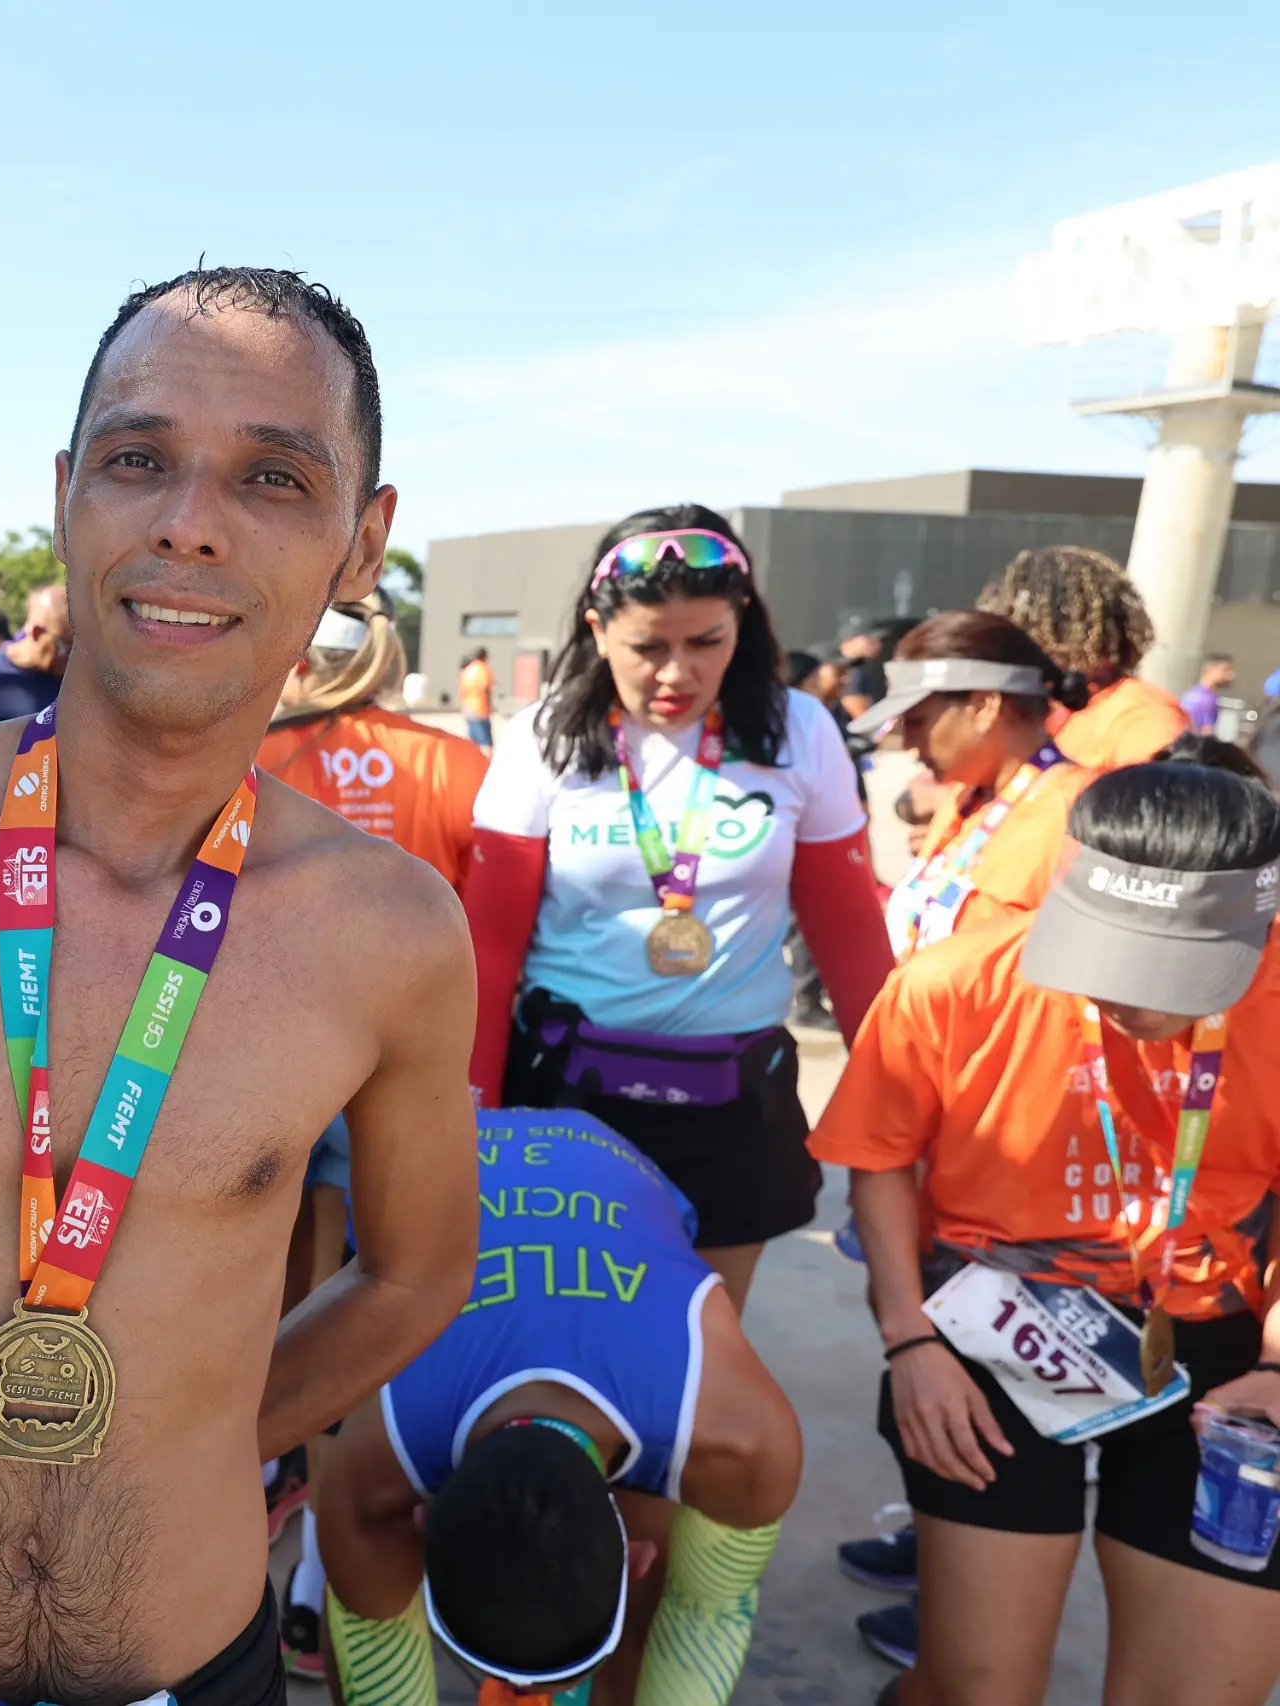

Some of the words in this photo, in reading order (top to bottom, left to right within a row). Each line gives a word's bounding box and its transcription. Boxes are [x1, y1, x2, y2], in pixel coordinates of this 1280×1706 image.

[39, 785, 49, 812] CENTRO
[186, 880, 206, 907] CENTRO
[1108, 874, 1184, 903] ALMT
[523, 1142, 552, 1166] 3
[29, 1197, 38, 1229] CENTRO
[460, 1244, 648, 1314] ATLE
[991, 1298, 1105, 1396] 1657
